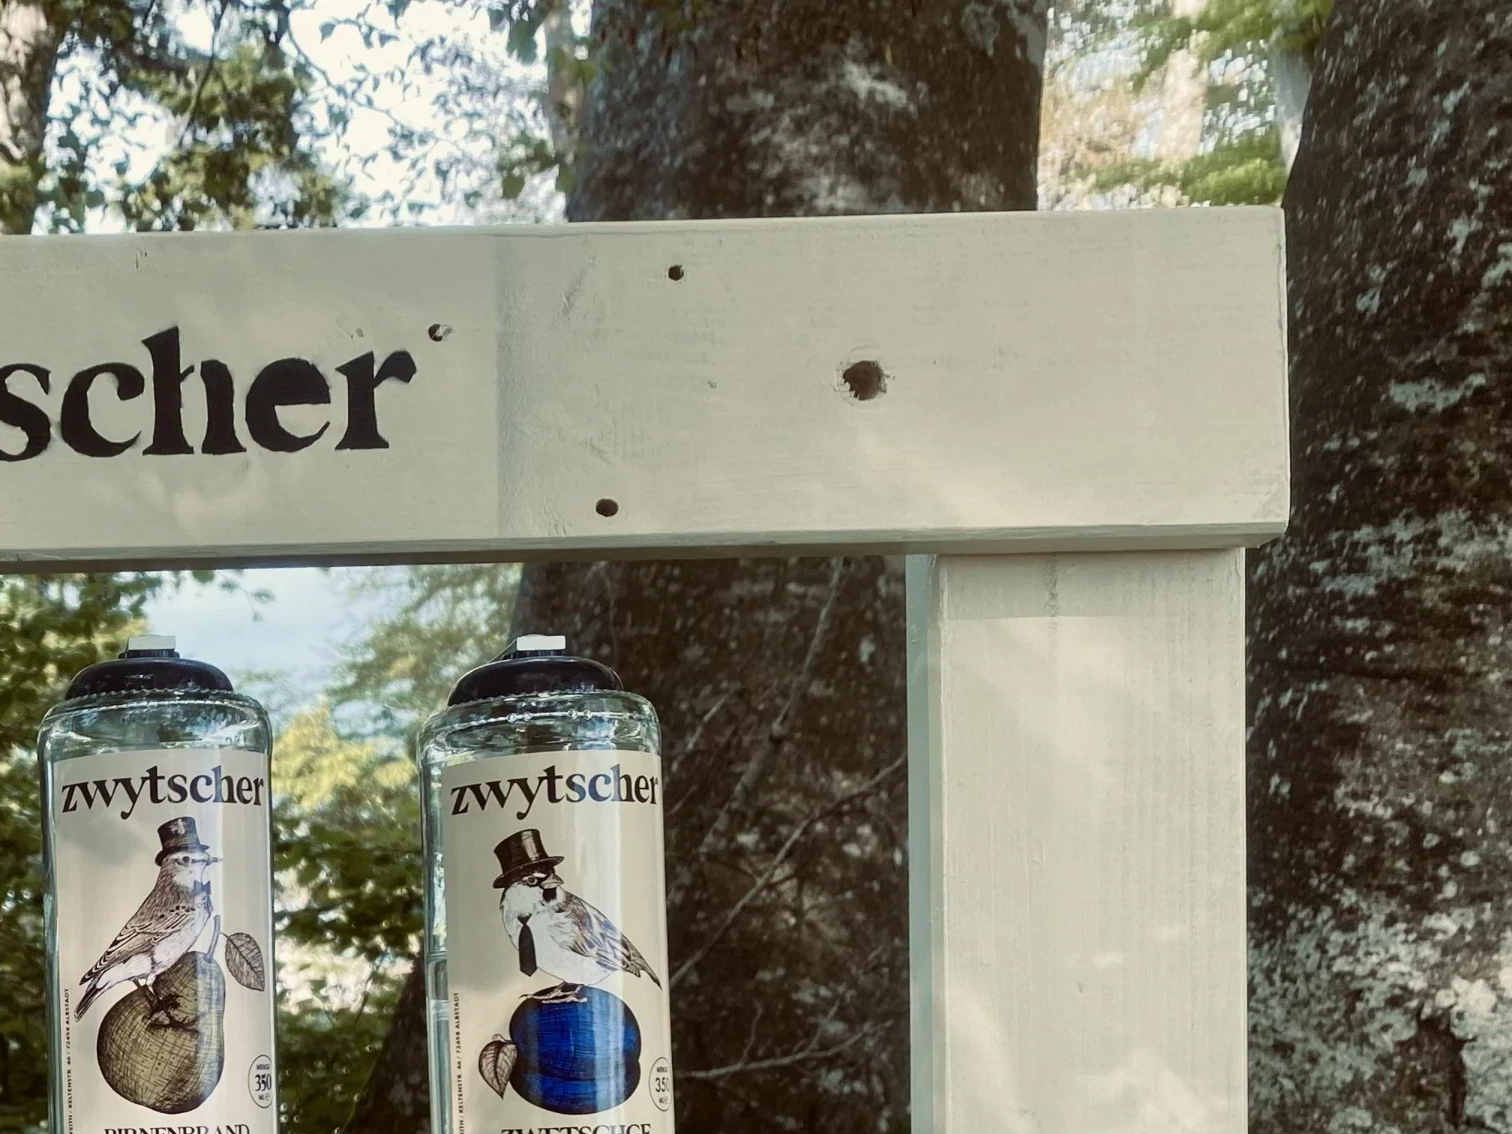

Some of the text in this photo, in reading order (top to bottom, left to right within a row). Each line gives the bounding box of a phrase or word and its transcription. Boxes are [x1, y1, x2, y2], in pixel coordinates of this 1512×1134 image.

[61, 765, 264, 820] zwytscher
[450, 763, 658, 820] zwytscher
[254, 1073, 272, 1091] 350
